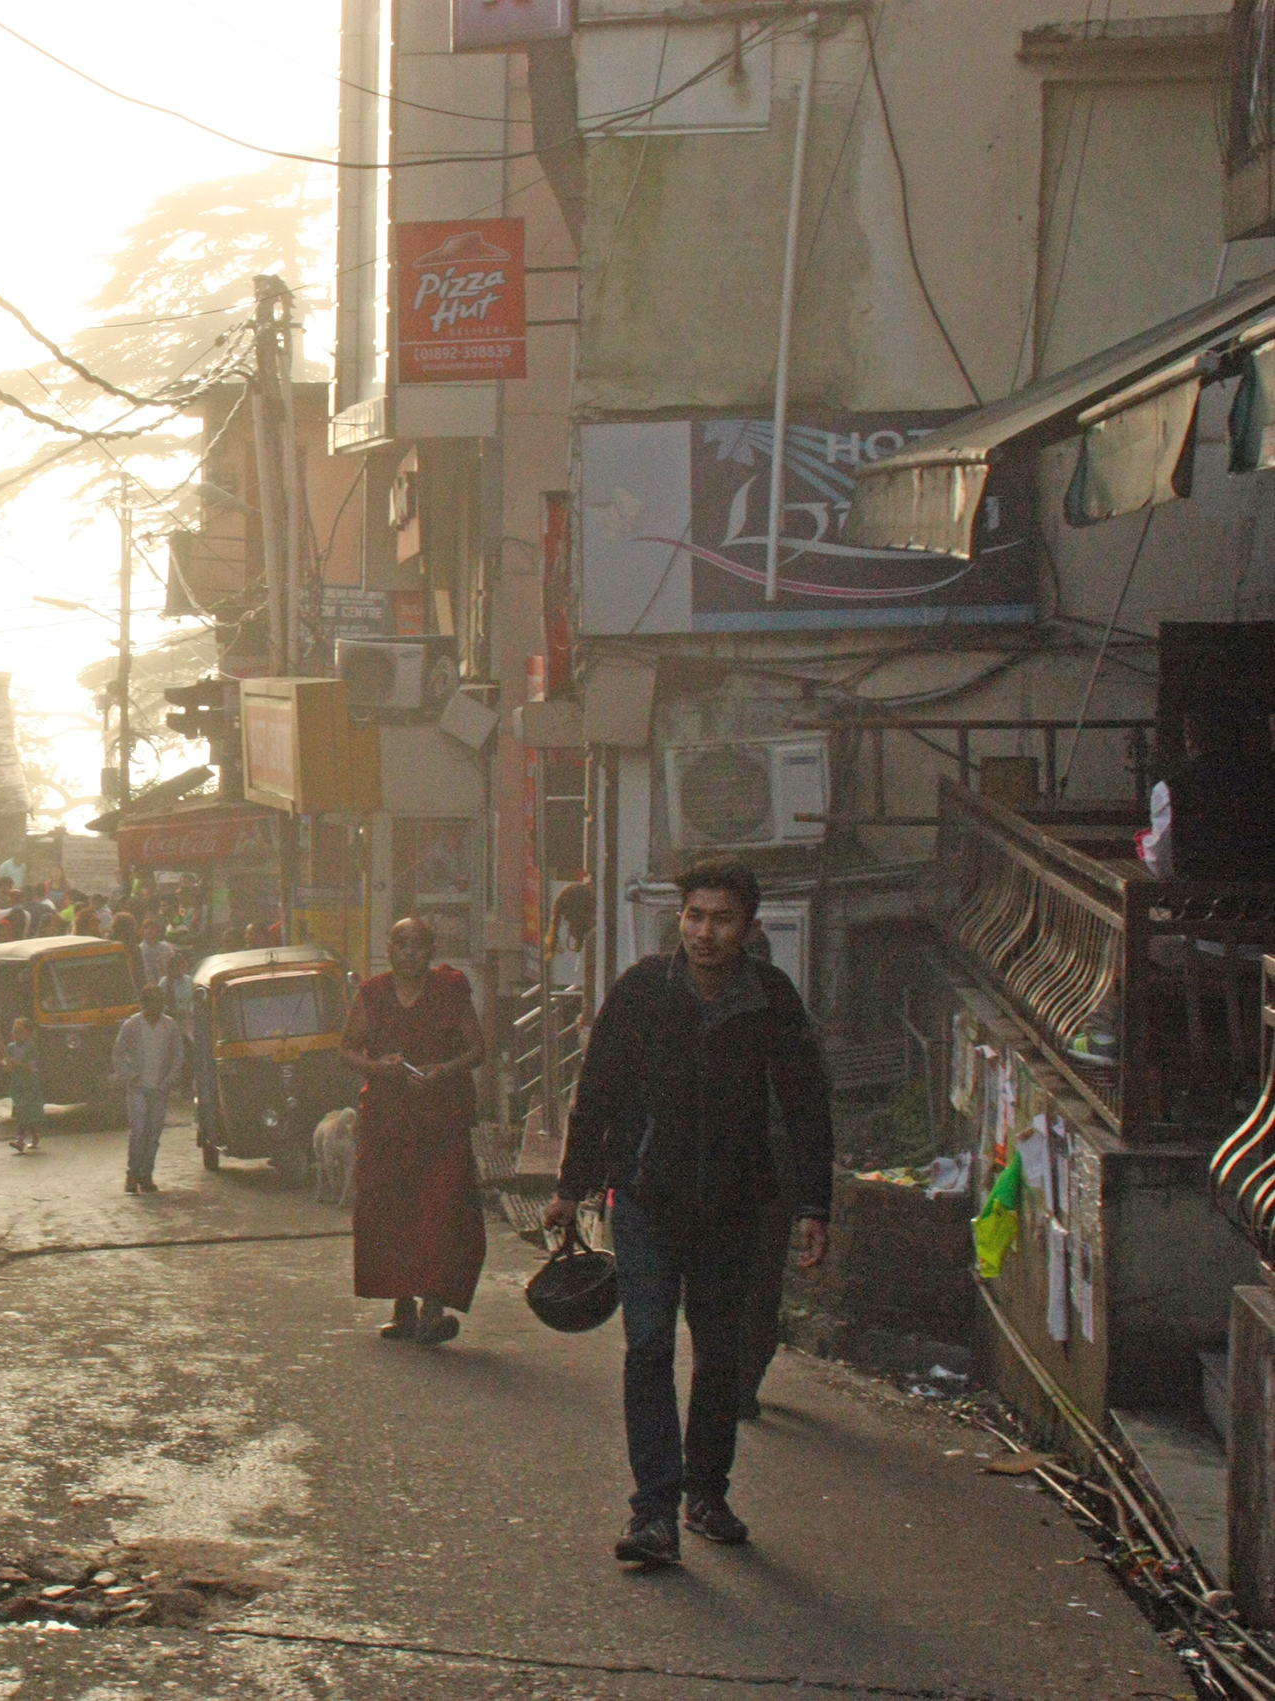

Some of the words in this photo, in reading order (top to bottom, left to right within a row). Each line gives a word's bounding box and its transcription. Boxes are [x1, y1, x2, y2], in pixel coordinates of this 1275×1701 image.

[413, 266, 507, 311] Pizza
[429, 292, 503, 333] Hut
[341, 606, 382, 618] CENTRE
